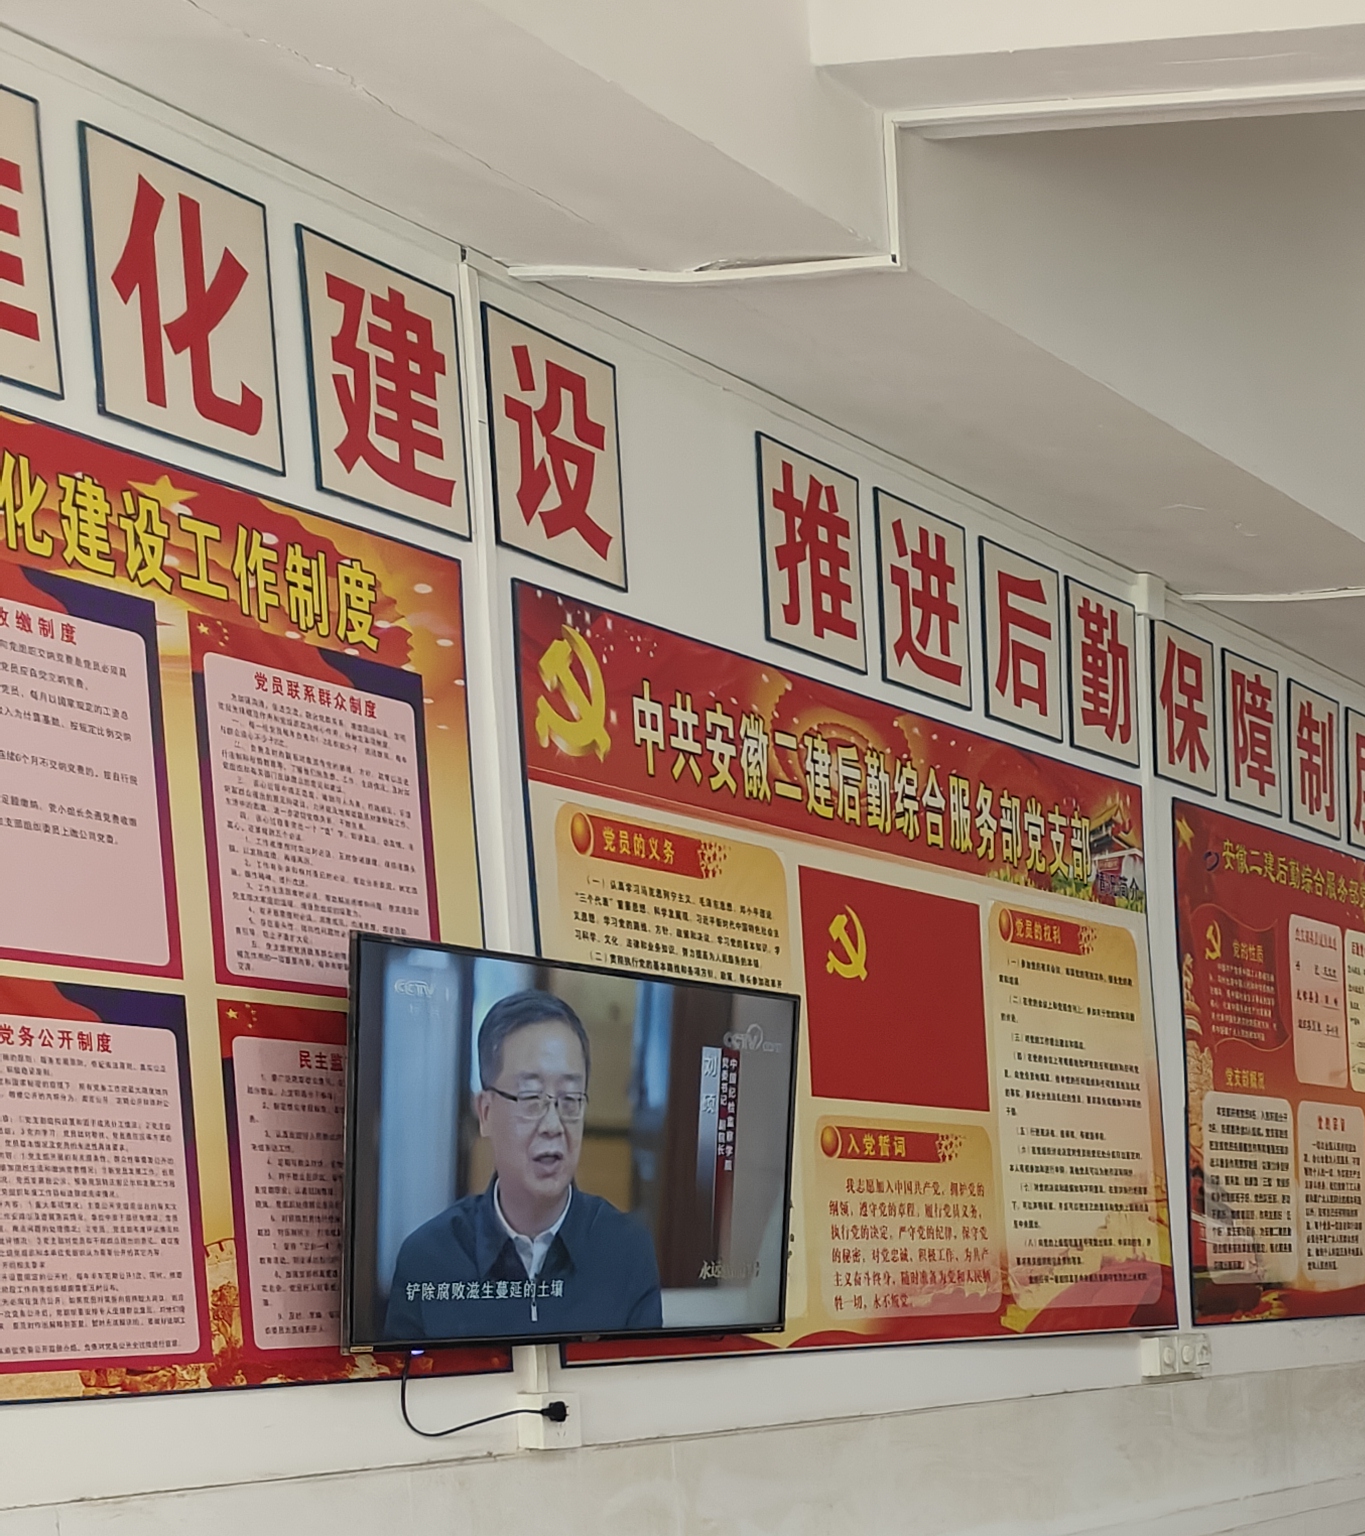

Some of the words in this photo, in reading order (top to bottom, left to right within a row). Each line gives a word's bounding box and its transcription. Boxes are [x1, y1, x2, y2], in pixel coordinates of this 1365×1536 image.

[0, 157, 613, 560] 化建设
[254, 671, 378, 719] 党员联系群众制度
[630, 679, 1093, 885] 中共安徽二建后勤综合服务部党支部
[602, 826, 675, 866] 党员的义务
[1015, 917, 1062, 944] 党员的权利
[847, 1133, 906, 1157] 入党誓词
[405, 1280, 565, 1302] 铲除腐败滋生蔓延的土壤
